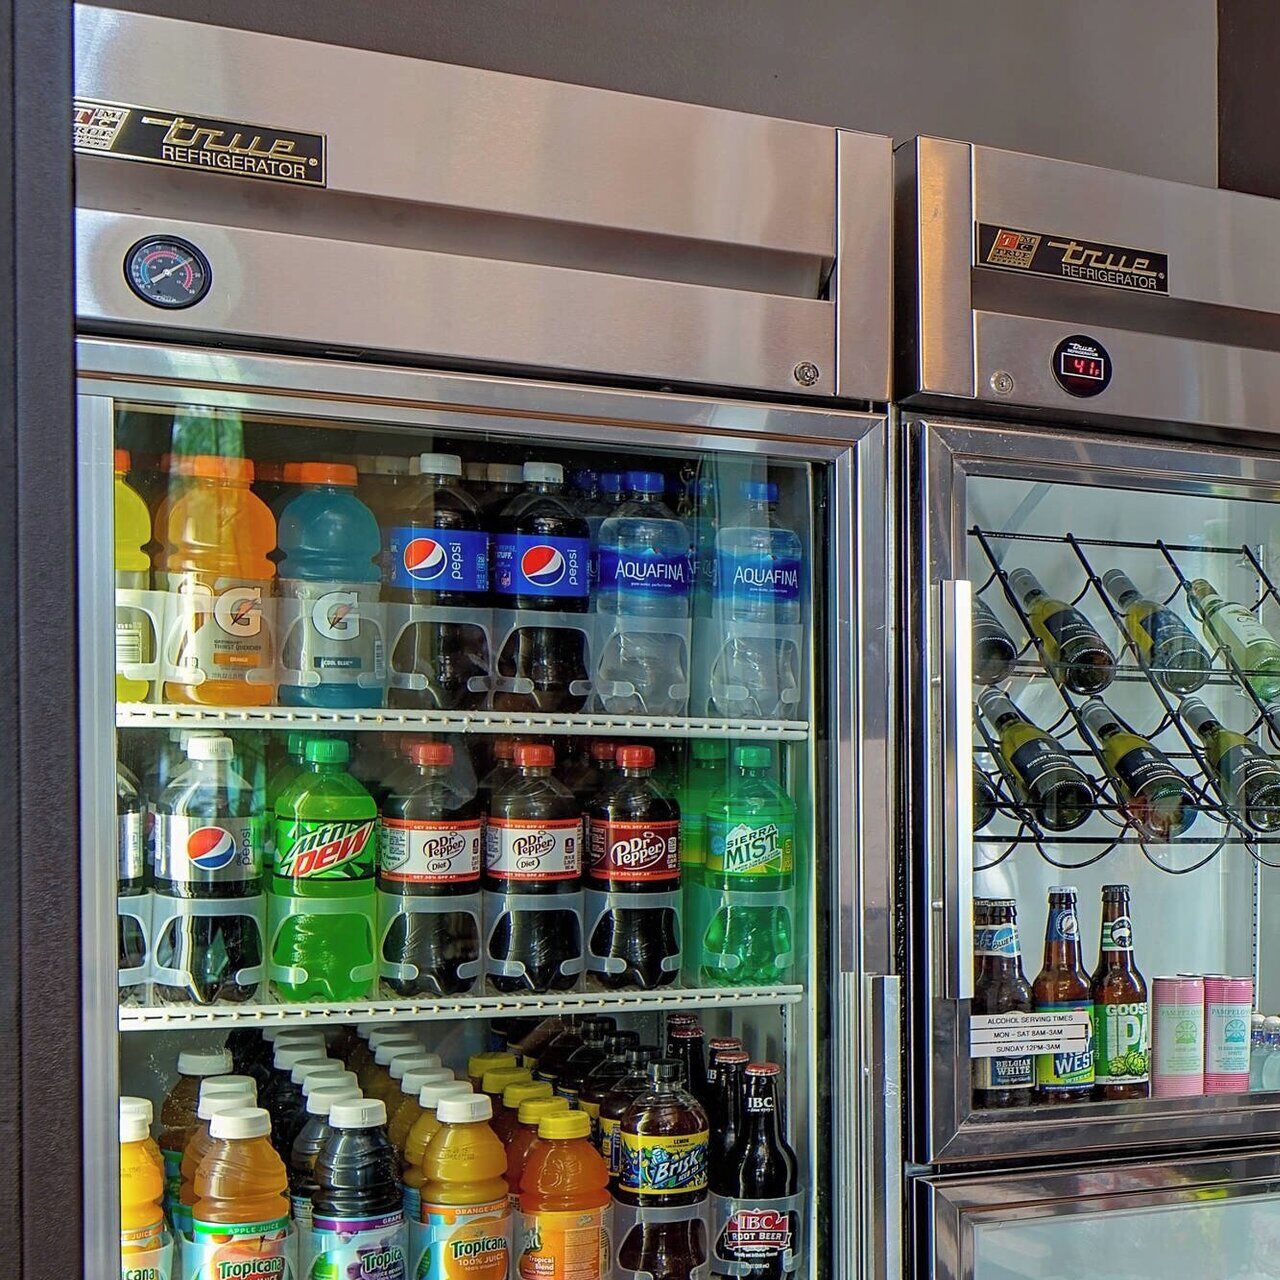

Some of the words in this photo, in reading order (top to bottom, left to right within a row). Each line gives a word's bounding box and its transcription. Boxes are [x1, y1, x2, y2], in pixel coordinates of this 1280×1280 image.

[162, 146, 306, 179] REFRIGERATOR
[1062, 263, 1157, 290] REFRIGERATOR
[451, 541, 462, 580] pepsi
[568, 549, 579, 586] pepsi
[615, 559, 685, 583] AQUAFINA
[734, 566, 799, 588] AQUAFINA
[726, 823, 775, 849] SIERRA
[423, 838, 464, 859] Pepper
[513, 838, 553, 859] Pepper
[612, 841, 663, 867] Pepper
[725, 832, 778, 872] MIST
[430, 860, 447, 871] Diet
[520, 860, 537, 869] Diet
[1106, 1003, 1148, 1016] GOOSE
[987, 1017, 1019, 1025] ALCOHOL
[1020, 1016, 1051, 1024] SERVING
[993, 1031, 1010, 1039] MON
[996, 1045, 1024, 1053] SUNDAY
[995, 1058, 1031, 1067] BELGIAN
[997, 1066, 1031, 1076] WHITE
[1055, 1051, 1094, 1075] WEST
[747, 1097, 774, 1108] IBC
[229, 1227, 256, 1235] APPLE
[258, 1223, 279, 1233] JUICE
[739, 1214, 775, 1231] IBC
[733, 1232, 756, 1241] ROOT
[759, 1232, 782, 1241] BEER
[451, 1237, 507, 1259] Tropicana
[217, 1257, 284, 1280] Tropicana
